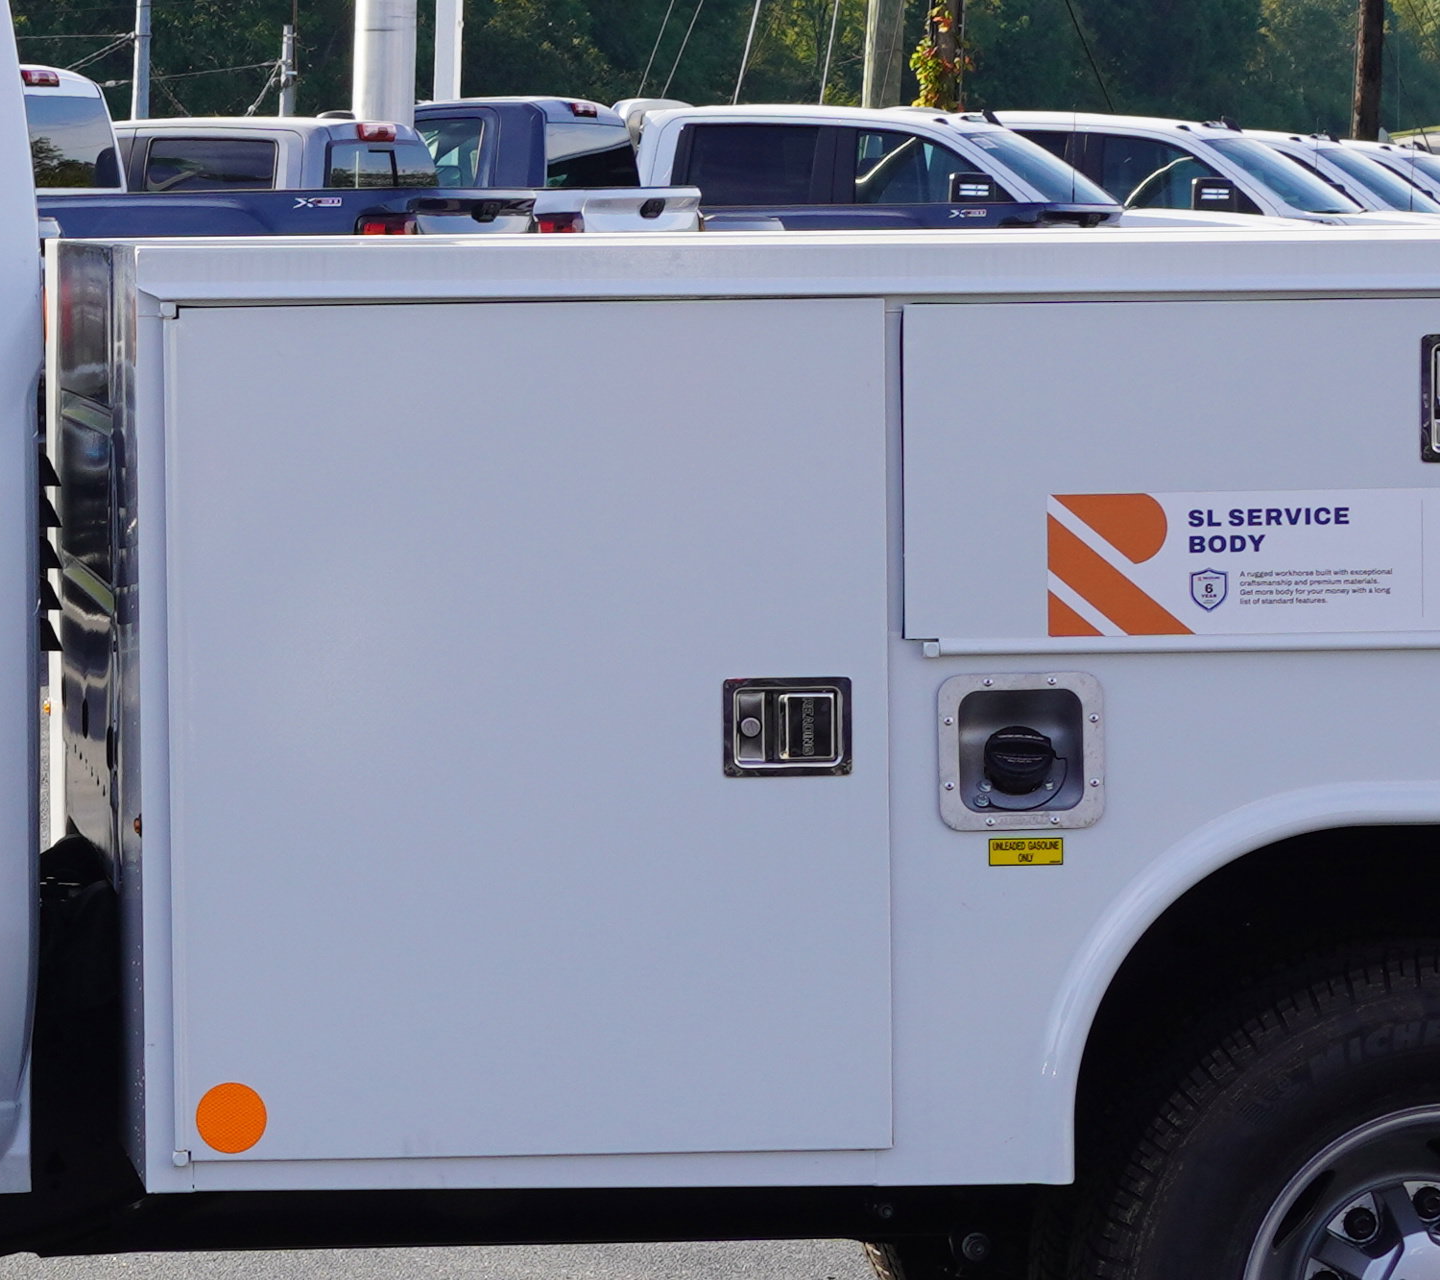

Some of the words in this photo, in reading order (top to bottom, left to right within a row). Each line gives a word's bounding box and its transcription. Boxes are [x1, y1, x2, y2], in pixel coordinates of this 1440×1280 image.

[1188, 509, 1222, 527] SL
[1228, 507, 1350, 526] SERVICE
[1188, 534, 1266, 553] BODY
[1247, 570, 1274, 578] rugged
[1350, 568, 1393, 576] exceptional
[1240, 579, 1292, 587] craftsmanship
[1205, 583, 1214, 594] 6
[1275, 588, 1293, 596] body
[1324, 588, 1350, 596] money
[1374, 587, 1391, 595] long
[992, 841, 1026, 851] UNLEADED
[1027, 840, 1059, 851] GASOLINE
[1018, 853, 1034, 862] ONLY
